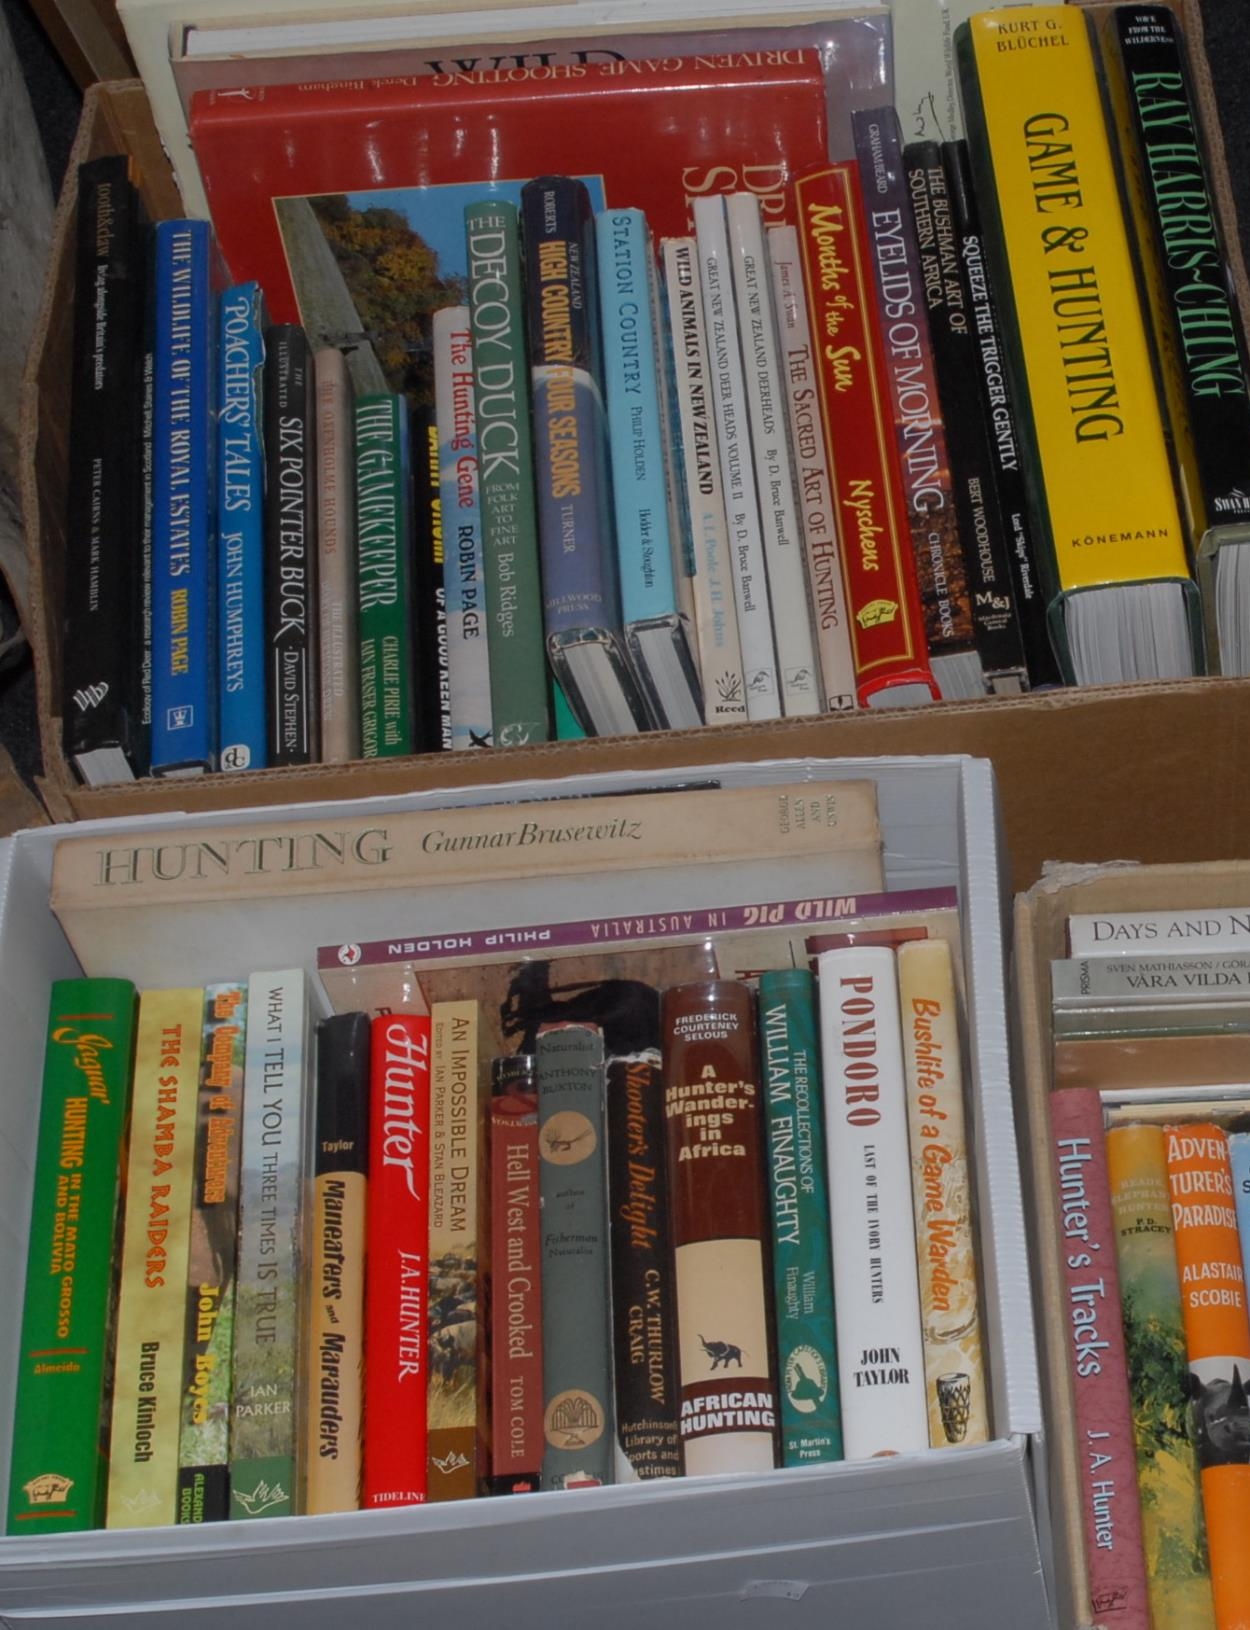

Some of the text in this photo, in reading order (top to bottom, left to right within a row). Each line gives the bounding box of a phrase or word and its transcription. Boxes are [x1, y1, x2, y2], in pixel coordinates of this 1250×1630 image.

[431, 59, 588, 86] SHOOTING
[594, 55, 686, 75] GAME
[692, 50, 808, 70] DRIVEN
[1131, 69, 1192, 132] RAY
[467, 217, 504, 231] THE
[808, 203, 862, 392] Months of the Sun
[1023, 113, 1124, 444] GAME & HUNTING
[612, 216, 641, 395] STATION COUNTRY
[469, 234, 520, 478] DECOY DUCK
[677, 247, 713, 495] WILD ANIMALS IN NEW ZEALAND
[872, 209, 943, 514] EYELIDS OF MORNING
[963, 236, 1019, 472] SQUEEZE THE TRIGGER GENTLY
[224, 435, 251, 513] TALES
[767, 449, 777, 463] By
[356, 400, 398, 612] THE GAMEKEEPER
[771, 481, 782, 506] Bruce
[274, 415, 306, 643] SIX POINTER BUCK
[774, 509, 790, 546] Banwell
[847, 480, 881, 573] Nyschens
[1072, 528, 1169, 547] KÖNEMANN
[92, 817, 643, 886] HUNTING Gunnar Brusewitz
[591, 898, 857, 938] WILD PIG IN AUSTRALIA
[1092, 918, 1164, 943] DAYS
[1167, 919, 1222, 938] AND
[1185, 969, 1244, 988] VILDA
[267, 987, 284, 1032] WHAT
[673, 1022, 739, 1036] COURTENEY
[676, 1013, 738, 1026] FREDERICK
[684, 1031, 728, 1042] SELOUS
[840, 976, 881, 1126] PONDORO
[52, 1027, 113, 1104] Jaguar
[264, 1048, 284, 1094] TELL
[701, 1065, 717, 1078] A
[382, 1024, 431, 1201] Hunter
[666, 1080, 756, 1101] Hunter's
[60, 1096, 88, 1169] HUNTING
[152, 1076, 178, 1176] SHAMBA
[262, 1099, 283, 1146] YOU
[450, 1017, 469, 1232] AN IMPOSSIBLE DREAM
[685, 1113, 734, 1128] ings
[700, 1129, 722, 1141] in
[765, 1003, 800, 1245] WILLIAM FINAUGHTY
[507, 1143, 531, 1182] Hell
[678, 1143, 747, 1162] Africa
[912, 998, 959, 1311] Bushlife of a Game Warden
[260, 1152, 278, 1202] THREE
[507, 1187, 531, 1227] West
[260, 1206, 277, 1255] TIMES
[508, 1231, 532, 1274] and
[258, 1262, 278, 1280] IS
[1057, 1138, 1110, 1377] Hunter's Tracks
[255, 1289, 277, 1345] TRUE
[320, 1179, 346, 1460] Maneaters and Marauders
[508, 1276, 534, 1359] Crooked
[853, 1369, 910, 1387] TAYLOR
[860, 1348, 900, 1365] JOHN
[134, 1341, 160, 1462] Bruce Kinloch
[680, 1411, 776, 1435] HUNTING
[681, 1393, 774, 1417] AFRICAN
